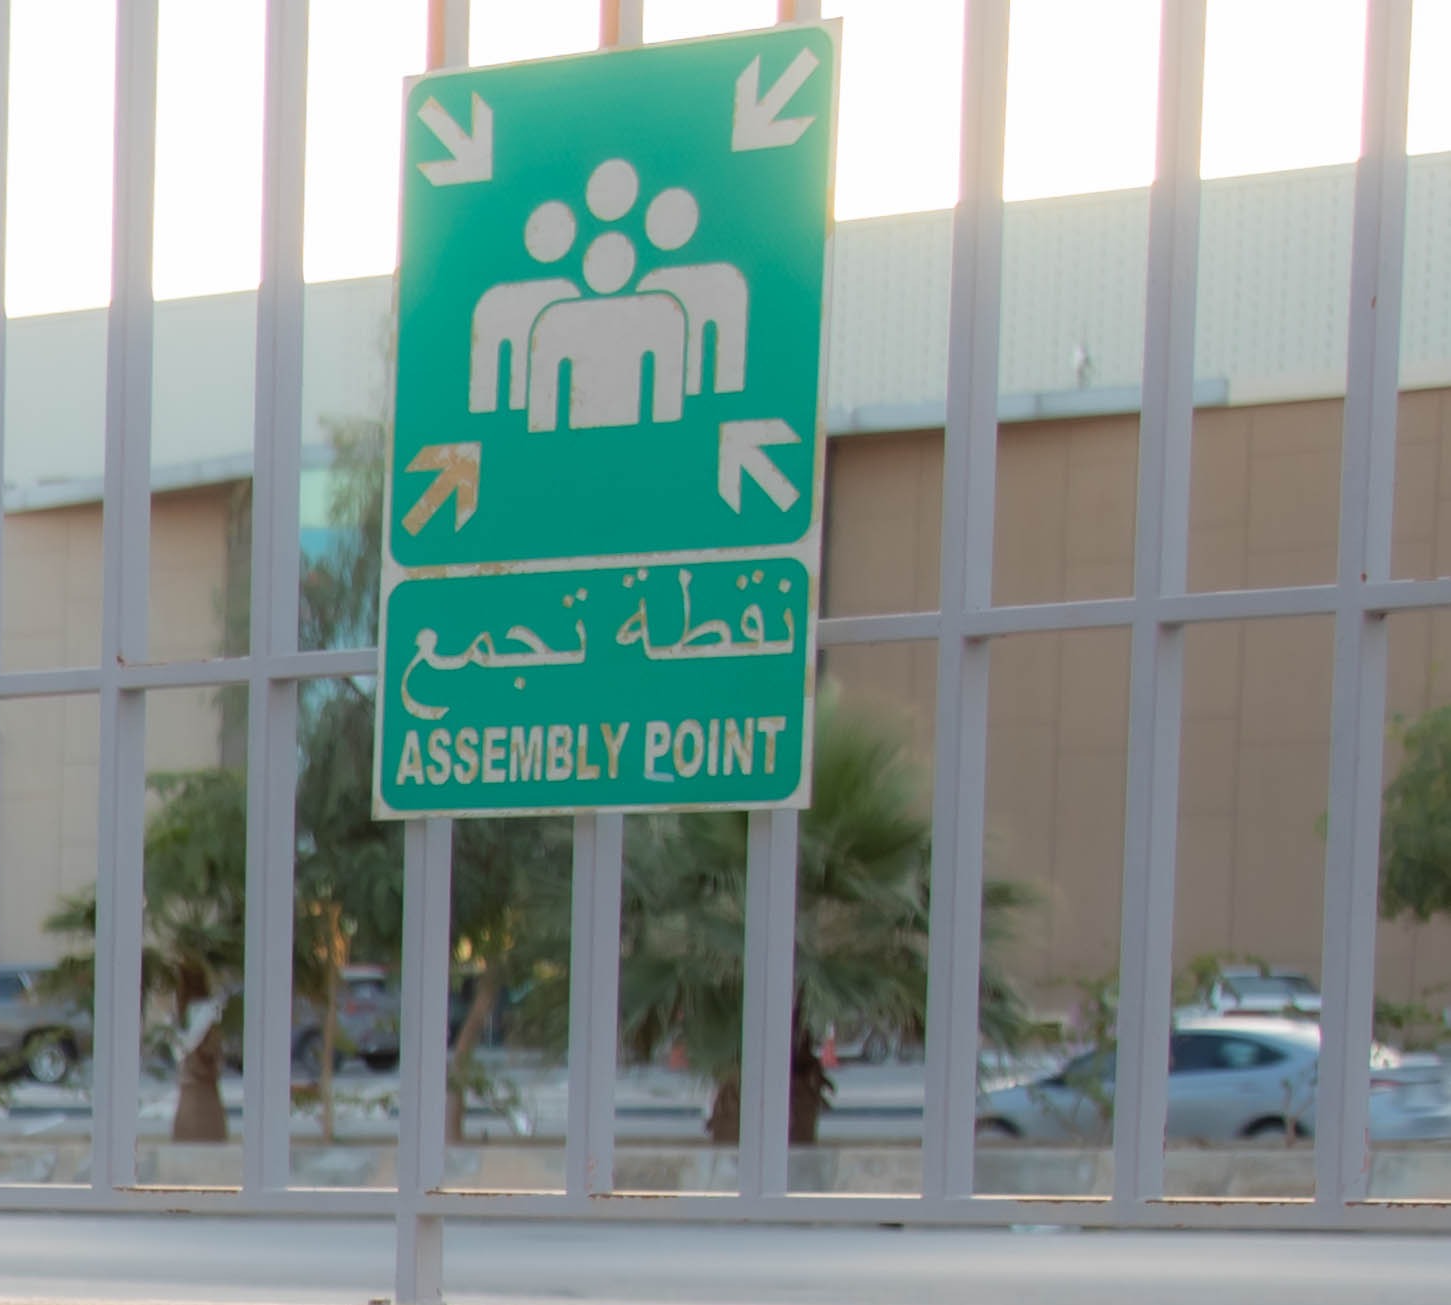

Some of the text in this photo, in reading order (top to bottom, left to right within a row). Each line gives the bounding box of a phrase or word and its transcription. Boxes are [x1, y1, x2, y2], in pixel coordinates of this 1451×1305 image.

[400, 567, 795, 720] نقطة تجمع
[395, 715, 787, 786] ASSEMBLY POINT
